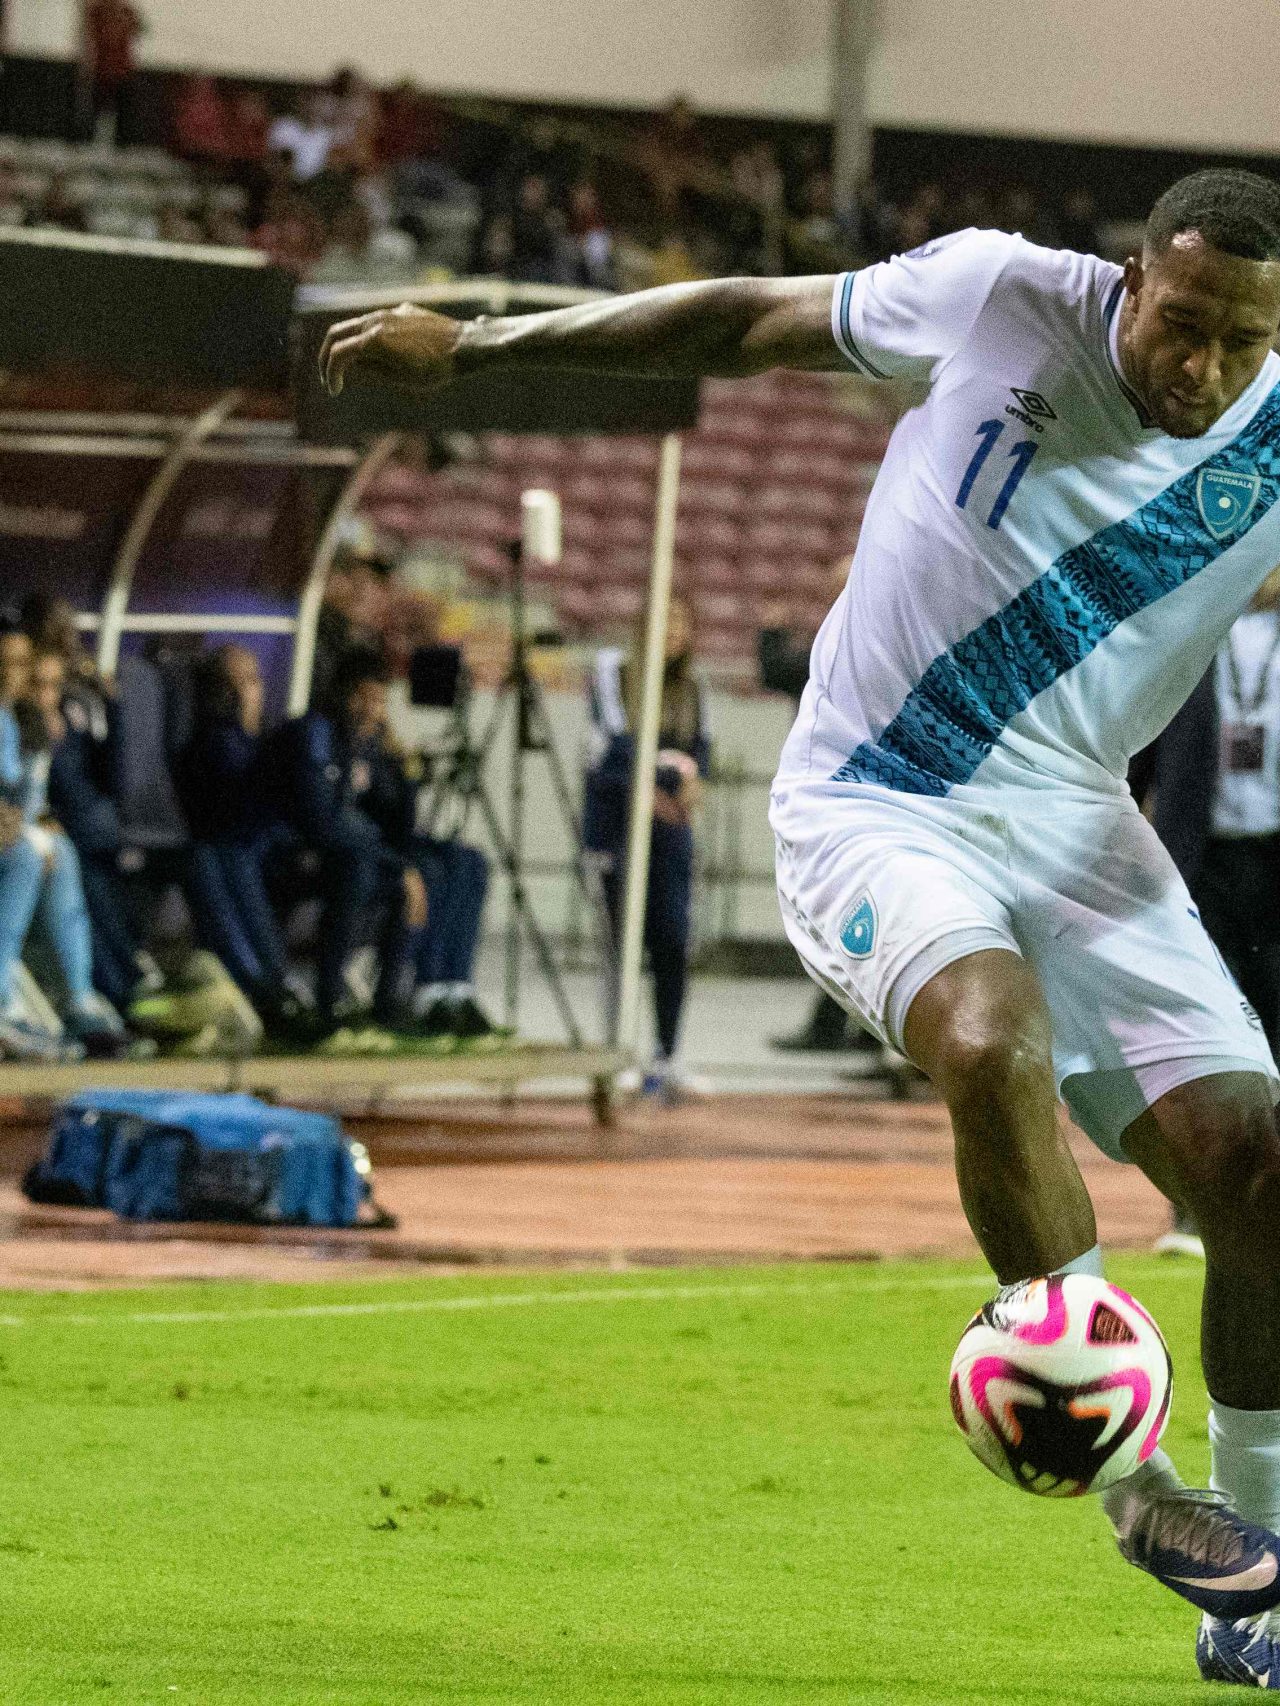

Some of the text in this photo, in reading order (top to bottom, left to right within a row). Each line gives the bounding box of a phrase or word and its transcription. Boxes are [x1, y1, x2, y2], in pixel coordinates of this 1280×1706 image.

[1005, 404, 1044, 433] umbro
[955, 419, 1039, 530] 11
[1206, 474, 1253, 489] GUATEMALA
